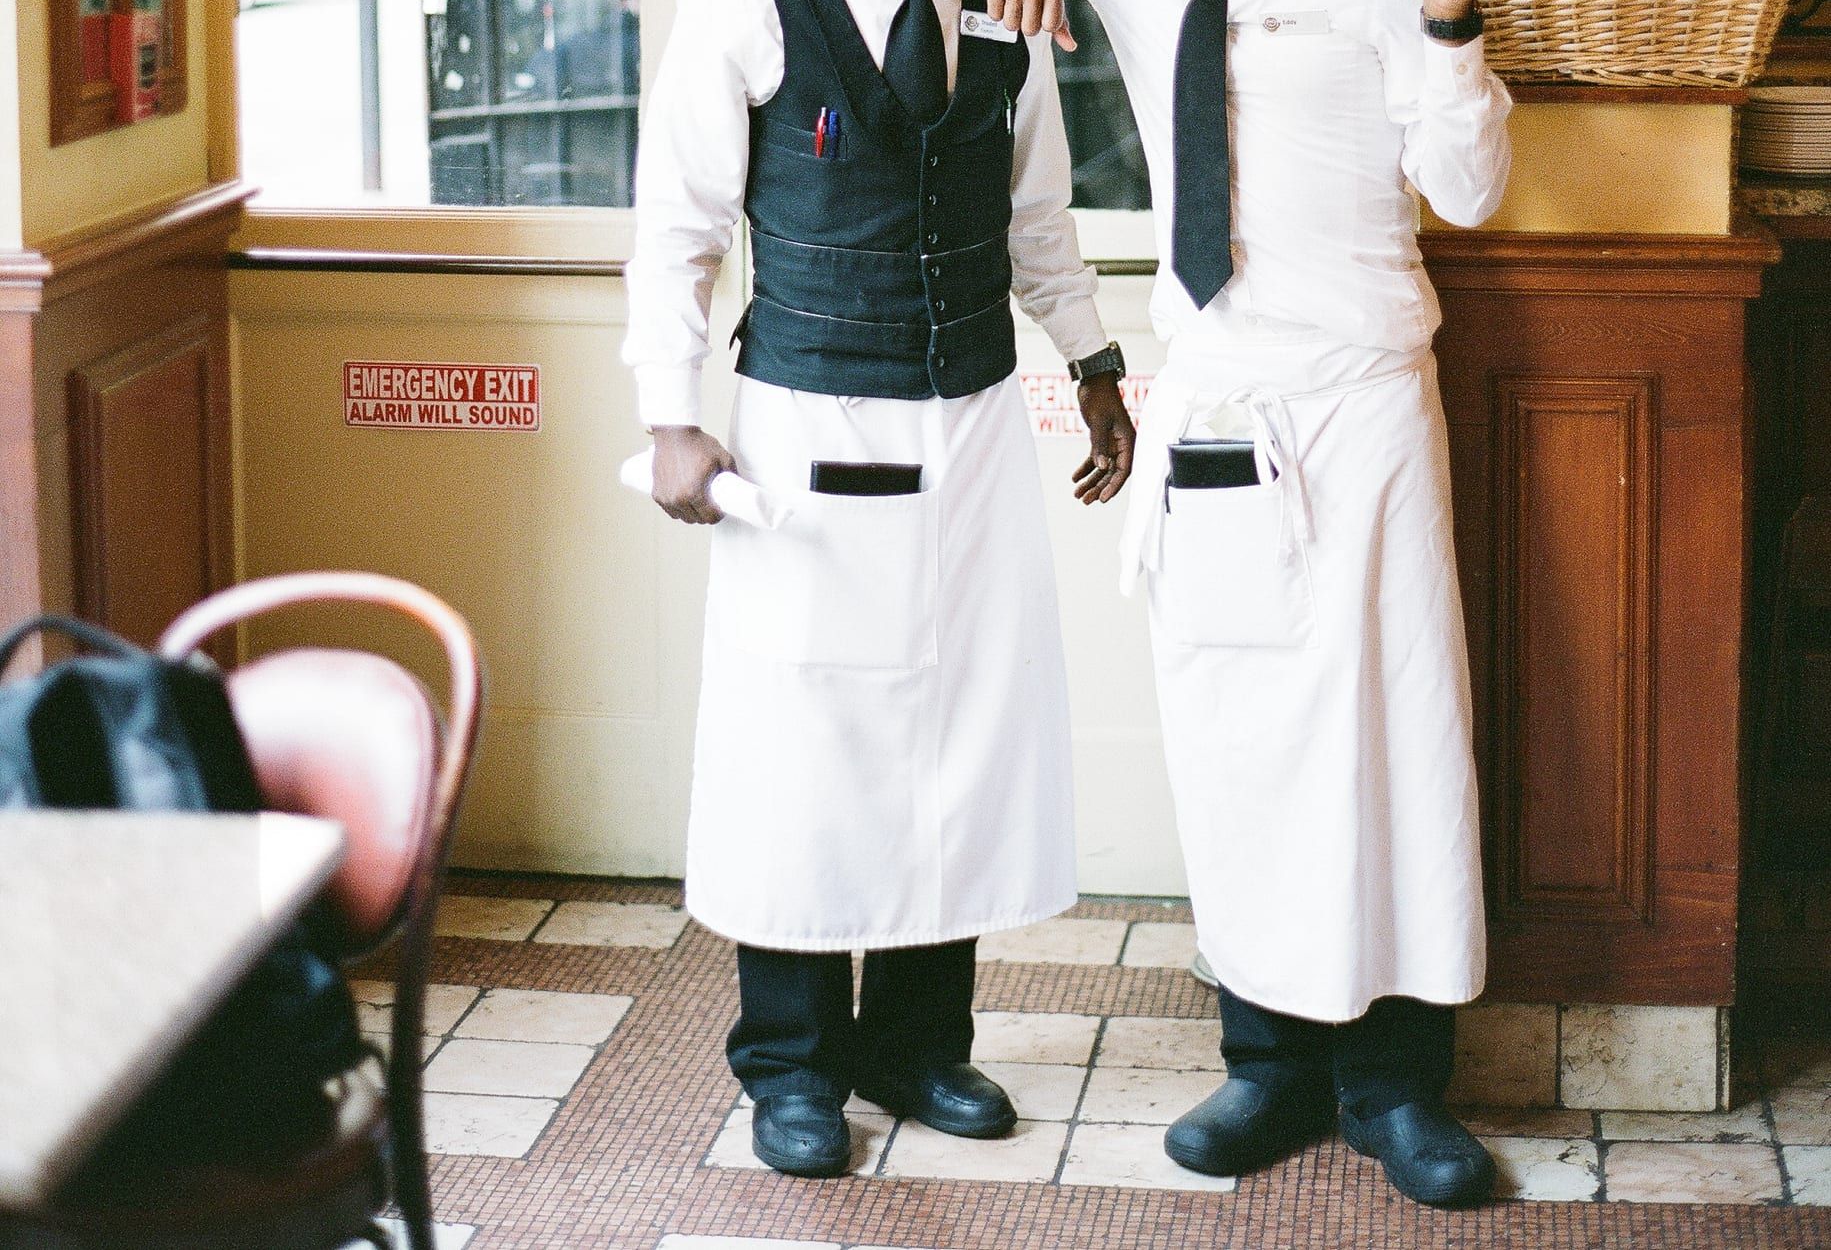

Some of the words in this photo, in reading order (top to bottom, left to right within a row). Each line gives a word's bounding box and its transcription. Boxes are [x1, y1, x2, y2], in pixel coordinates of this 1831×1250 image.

[349, 366, 477, 401] EMERGENCY
[484, 370, 534, 402] EXIT
[349, 402, 412, 423] ALARM
[418, 404, 463, 424] WILL
[468, 405, 535, 426] SOUND
[1039, 415, 1083, 434] WILL
